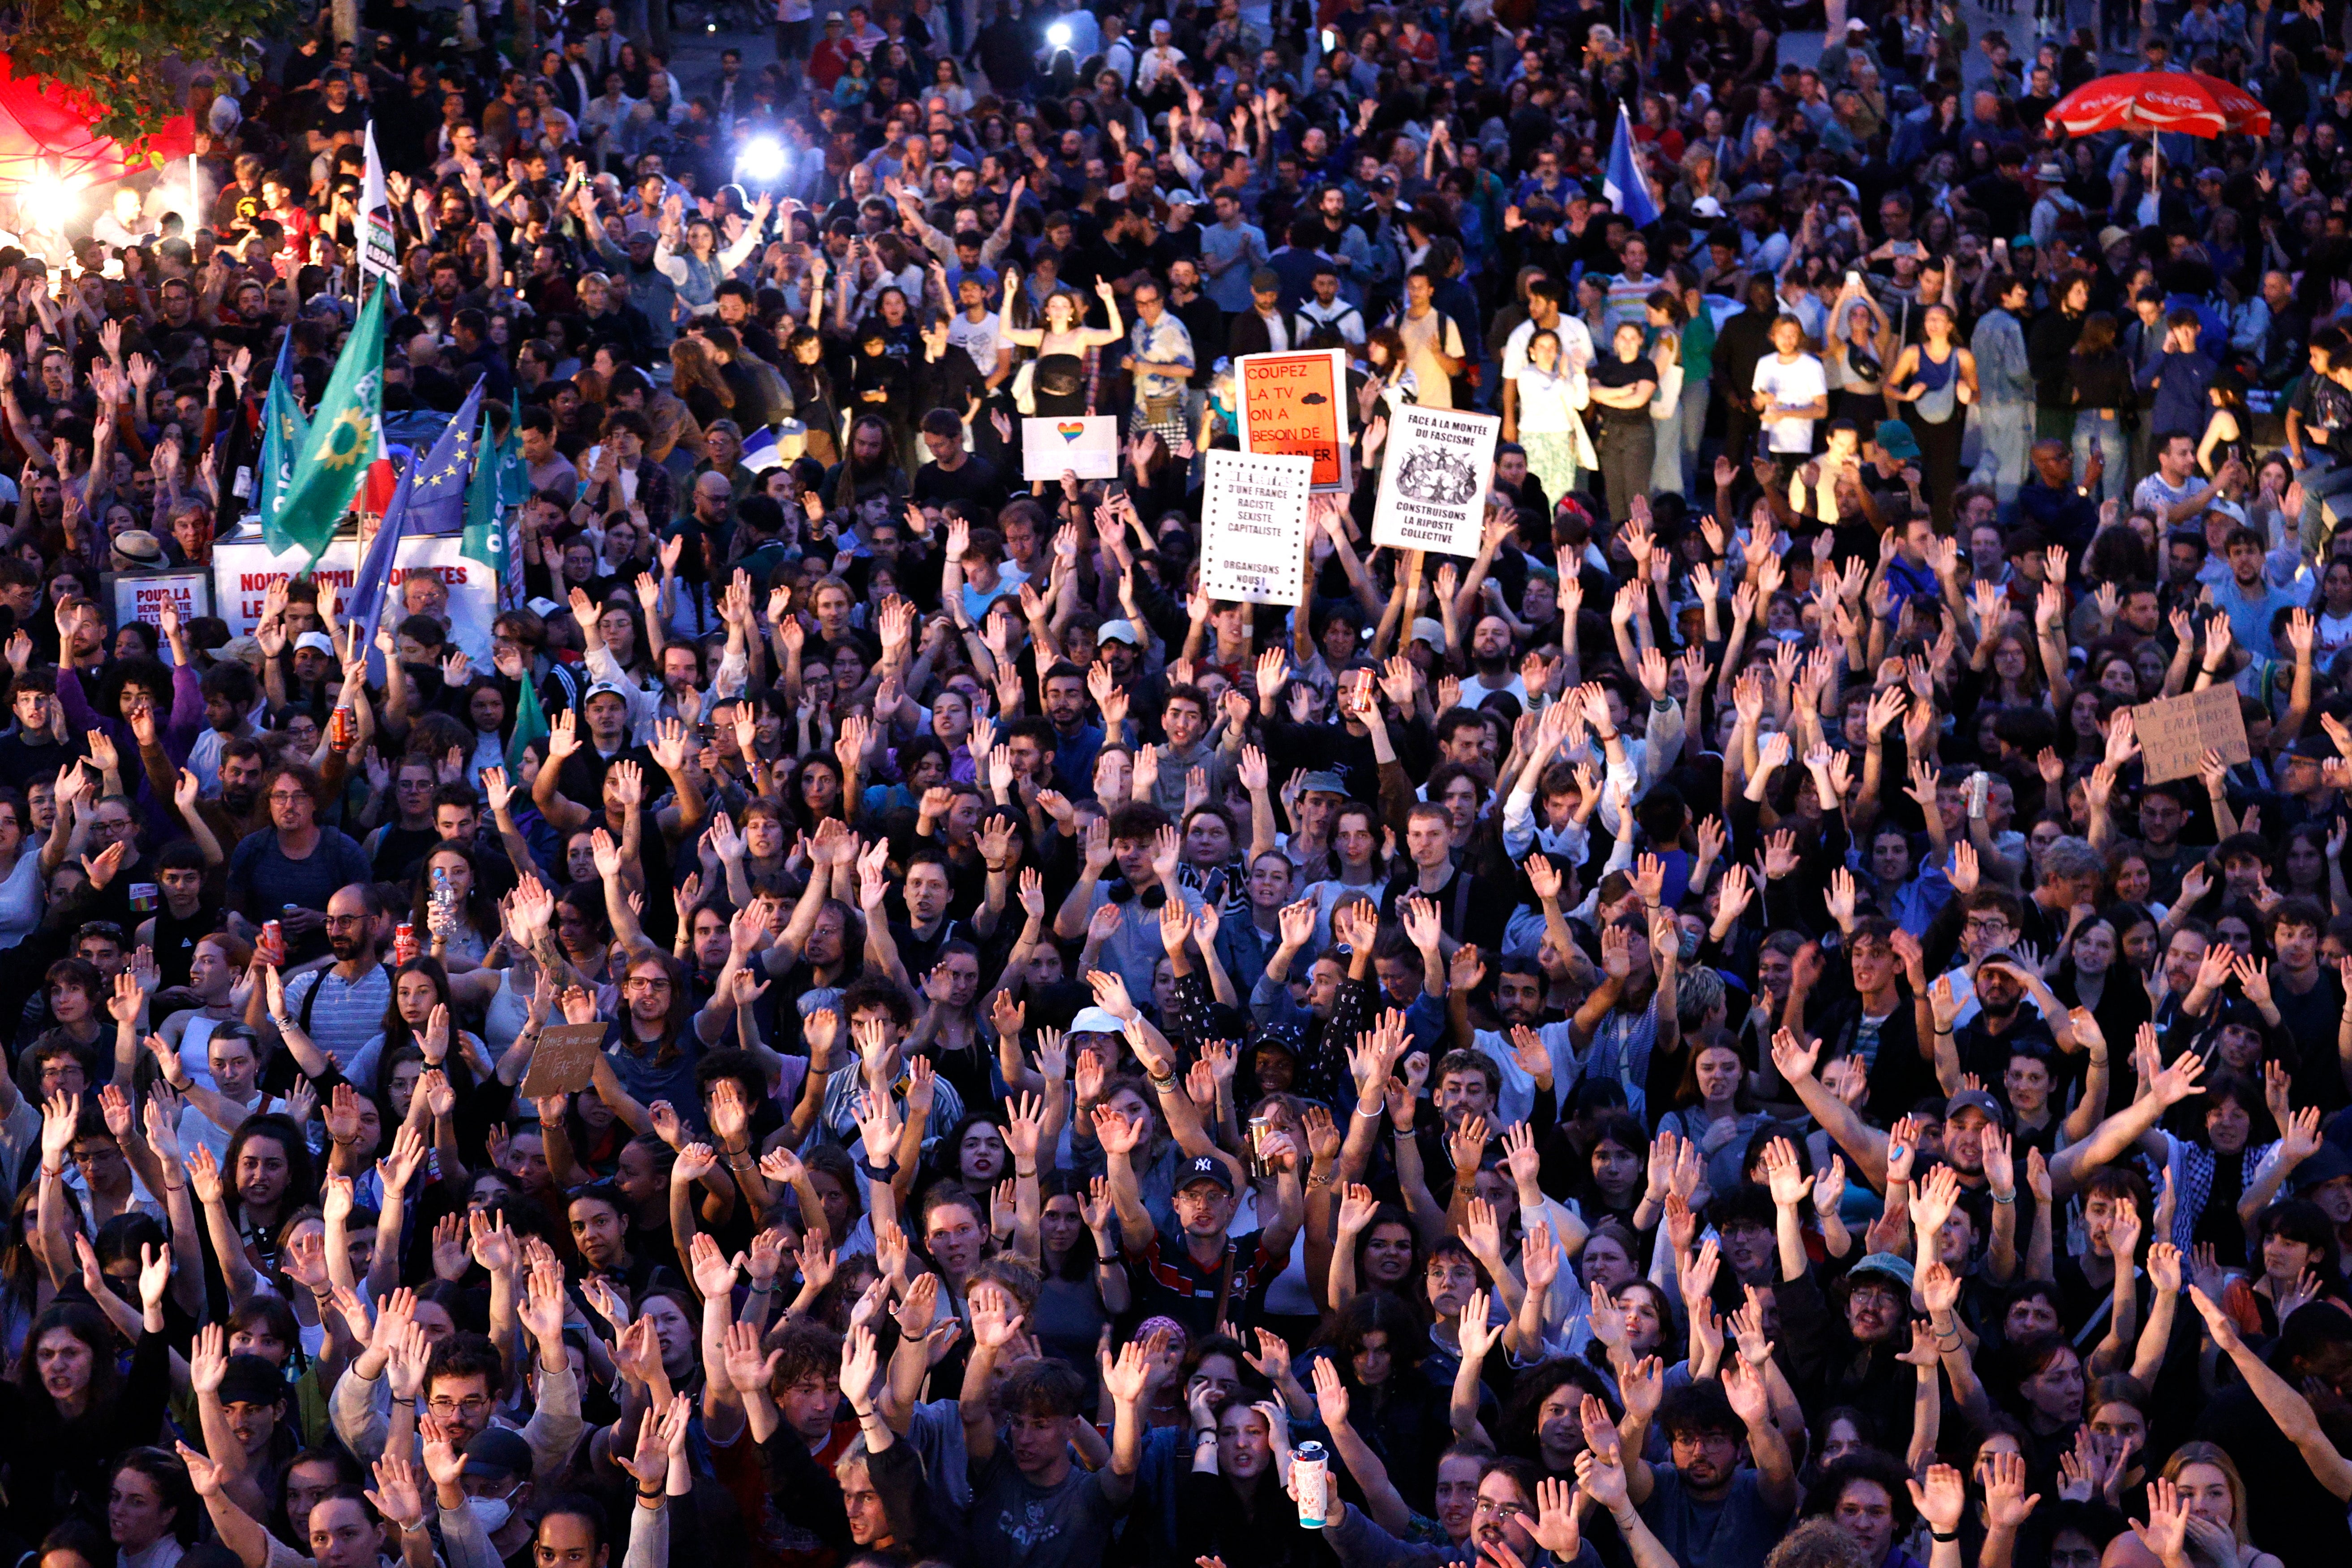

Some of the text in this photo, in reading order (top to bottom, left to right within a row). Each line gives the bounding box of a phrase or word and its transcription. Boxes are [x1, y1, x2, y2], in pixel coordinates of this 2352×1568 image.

[1247, 365, 1307, 380] COUPEZ
[1249, 387, 1293, 401] LA TV
[1250, 408, 1289, 421] ON A
[1408, 414, 1488, 436] FACE À LA MONTÉE
[1252, 427, 1320, 442] BESOIN DE
[1416, 428, 1476, 447] DU FASCISME
[1255, 487, 1288, 499] FRANCE
[1396, 501, 1467, 521] CONSTRUISONS
[1228, 522, 1282, 537] CAPITALISTE
[1404, 516, 1454, 532] LA RIPOSTE
[1401, 527, 1453, 544] COLLECTIVE
[1223, 560, 1280, 575] ORGANISONS
[174, 587, 191, 600] LA
[2136, 707, 2157, 720] LA
[1195, 1158, 1211, 1171] NY
